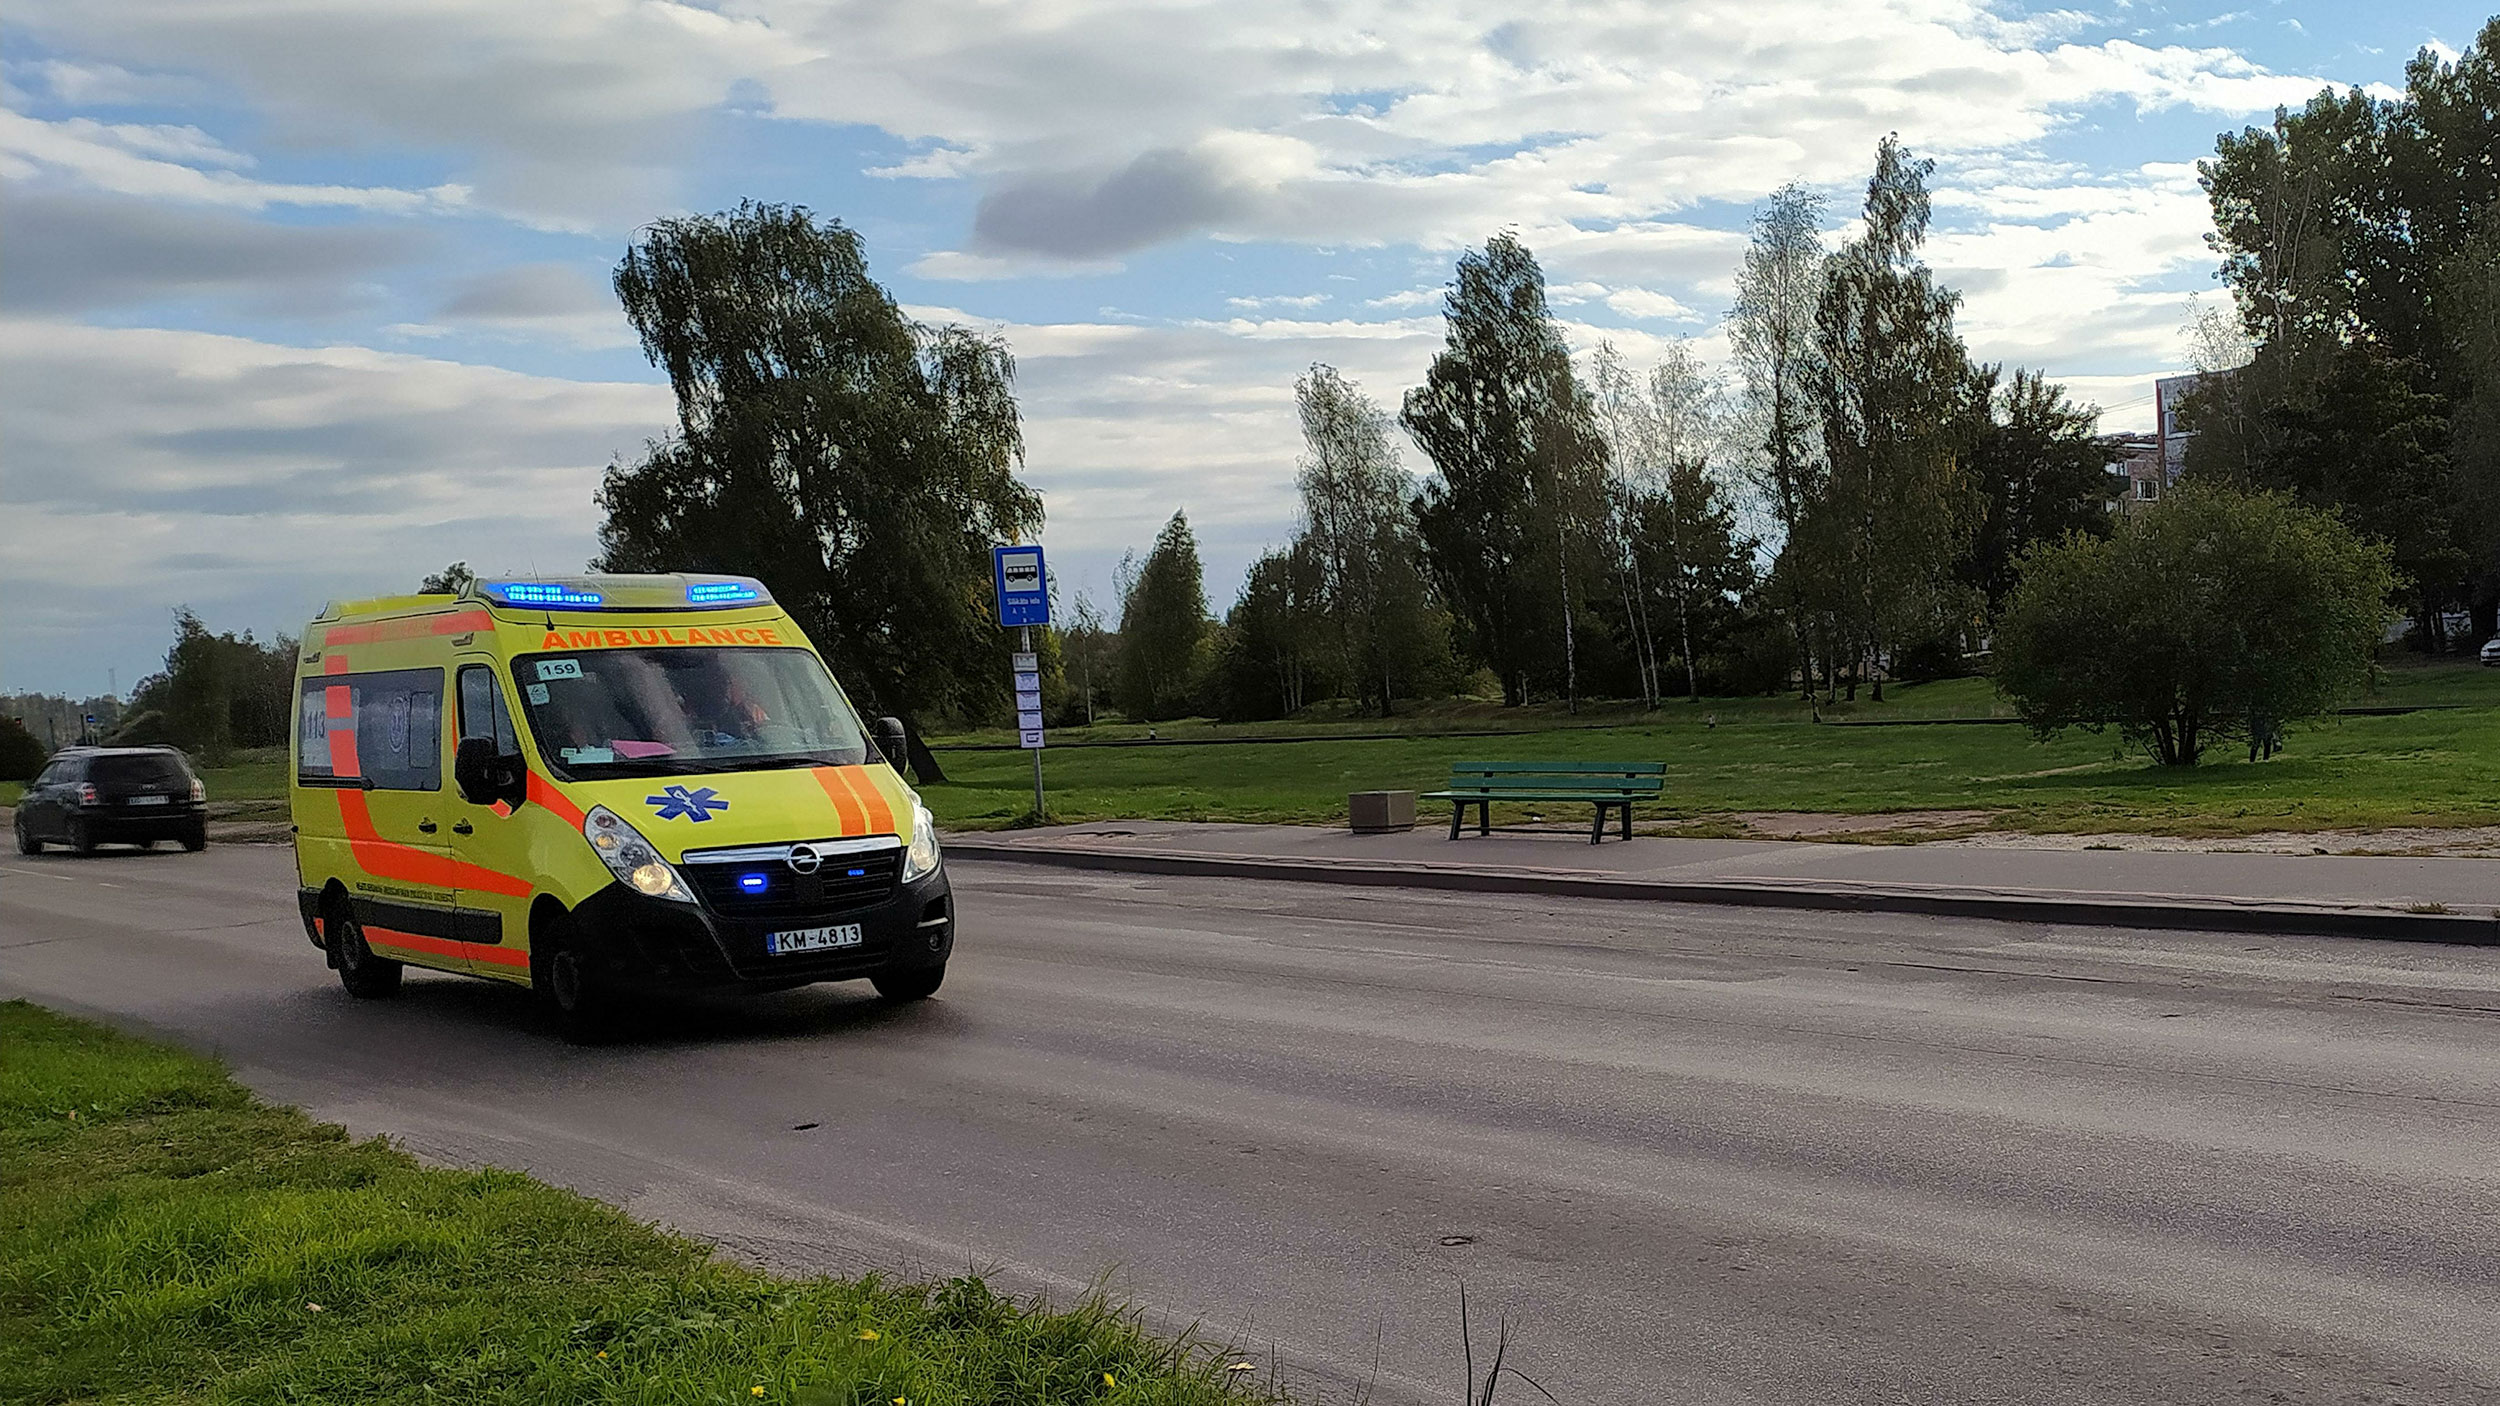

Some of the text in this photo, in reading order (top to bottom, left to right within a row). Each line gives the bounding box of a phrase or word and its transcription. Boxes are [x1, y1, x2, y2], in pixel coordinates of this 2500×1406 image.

[542, 627, 783, 650] AMBULANCE
[543, 663, 576, 676] 159
[779, 926, 860, 950] KM-4813
